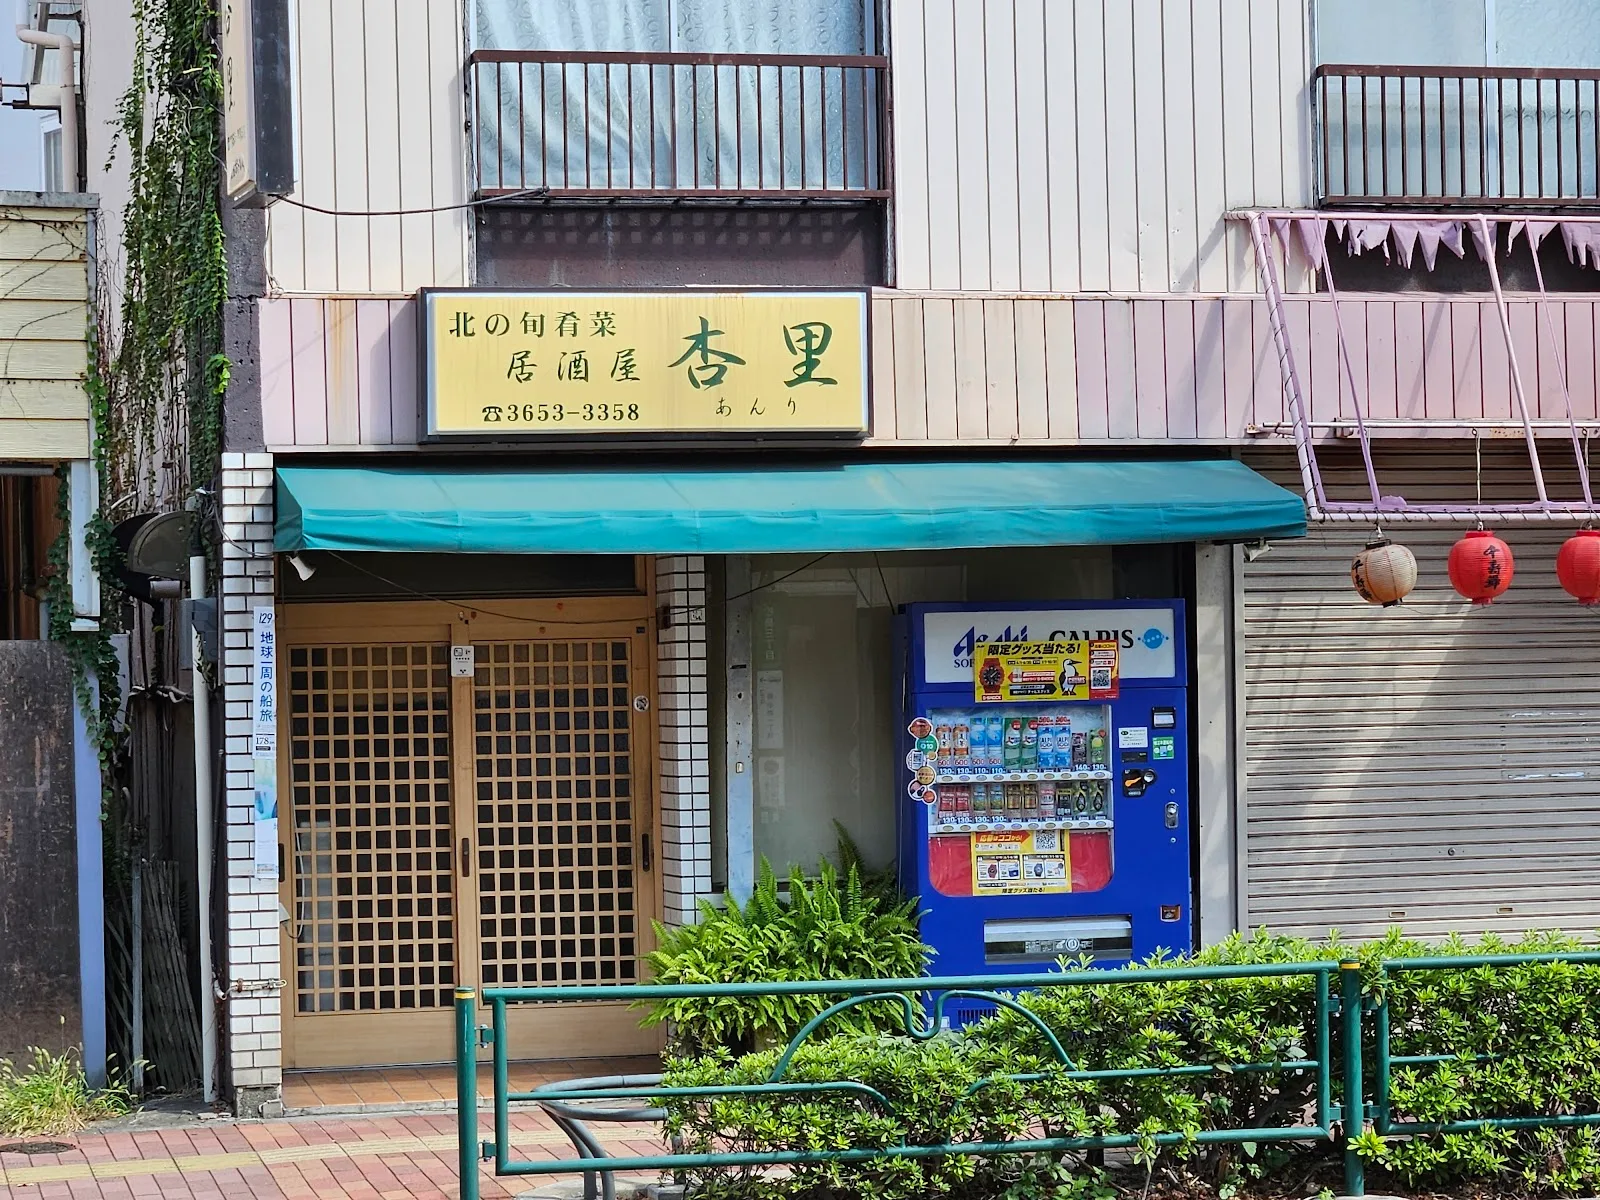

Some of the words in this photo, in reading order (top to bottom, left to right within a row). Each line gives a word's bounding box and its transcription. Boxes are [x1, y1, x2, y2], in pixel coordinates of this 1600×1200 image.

[449, 311, 617, 338] 北の旬肴菜
[506, 348, 641, 383] 居酒屋
[667, 316, 838, 391] 杏里
[507, 403, 640, 422] 3653-3358
[715, 396, 797, 416] あんり
[258, 612, 273, 624] 129
[260, 631, 273, 722] 地球一周の船旅
